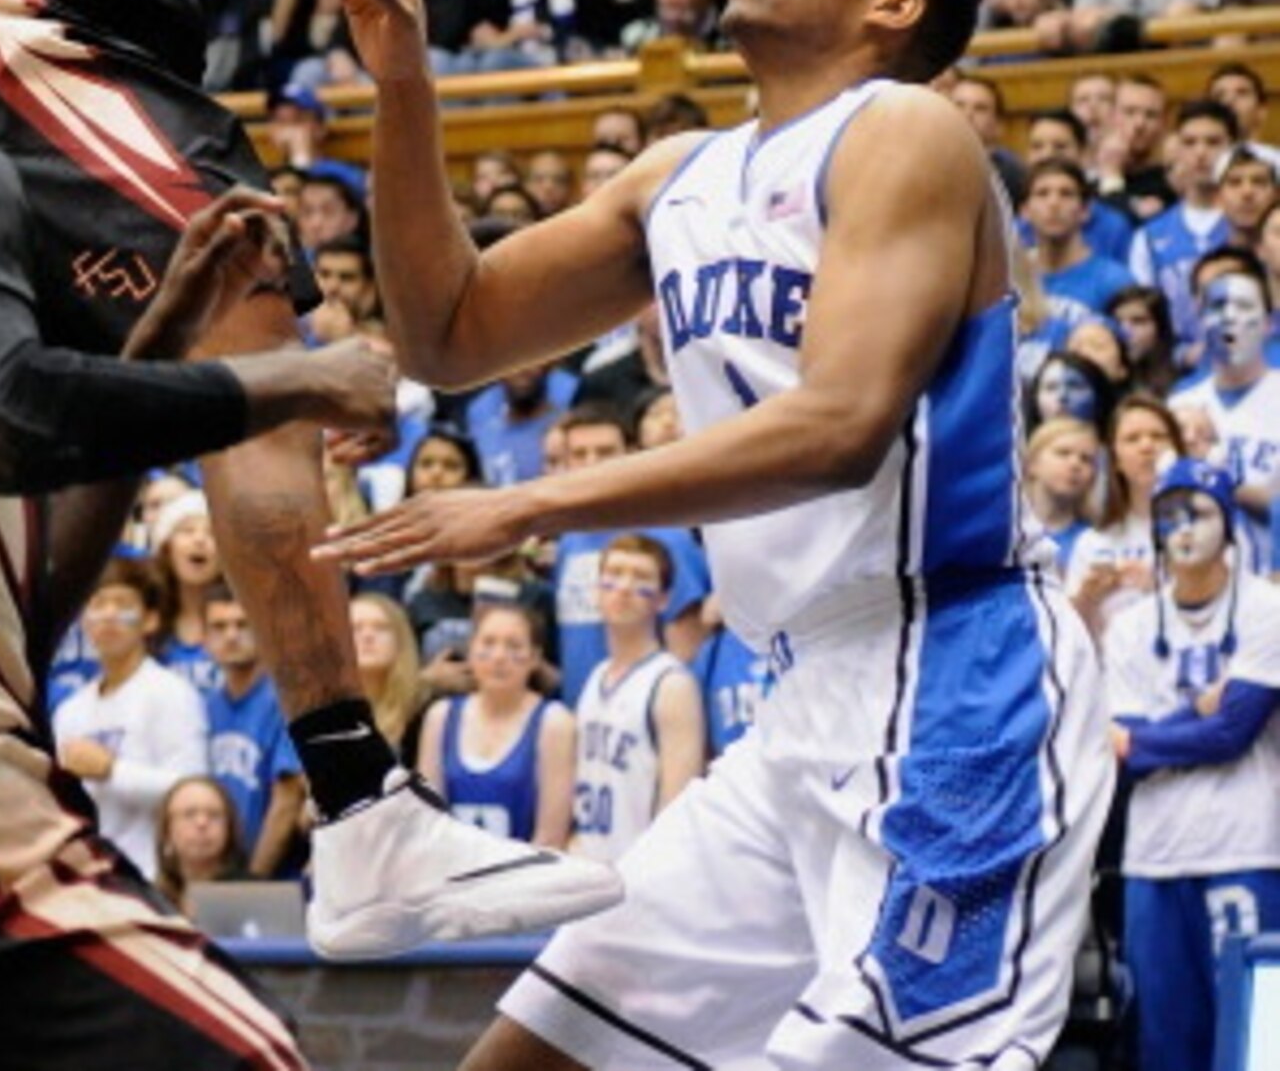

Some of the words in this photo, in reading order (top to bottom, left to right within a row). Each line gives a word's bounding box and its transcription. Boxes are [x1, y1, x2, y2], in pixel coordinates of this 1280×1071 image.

[71, 246, 156, 302] FSU
[659, 257, 814, 353] DUKE
[896, 884, 957, 966] D
